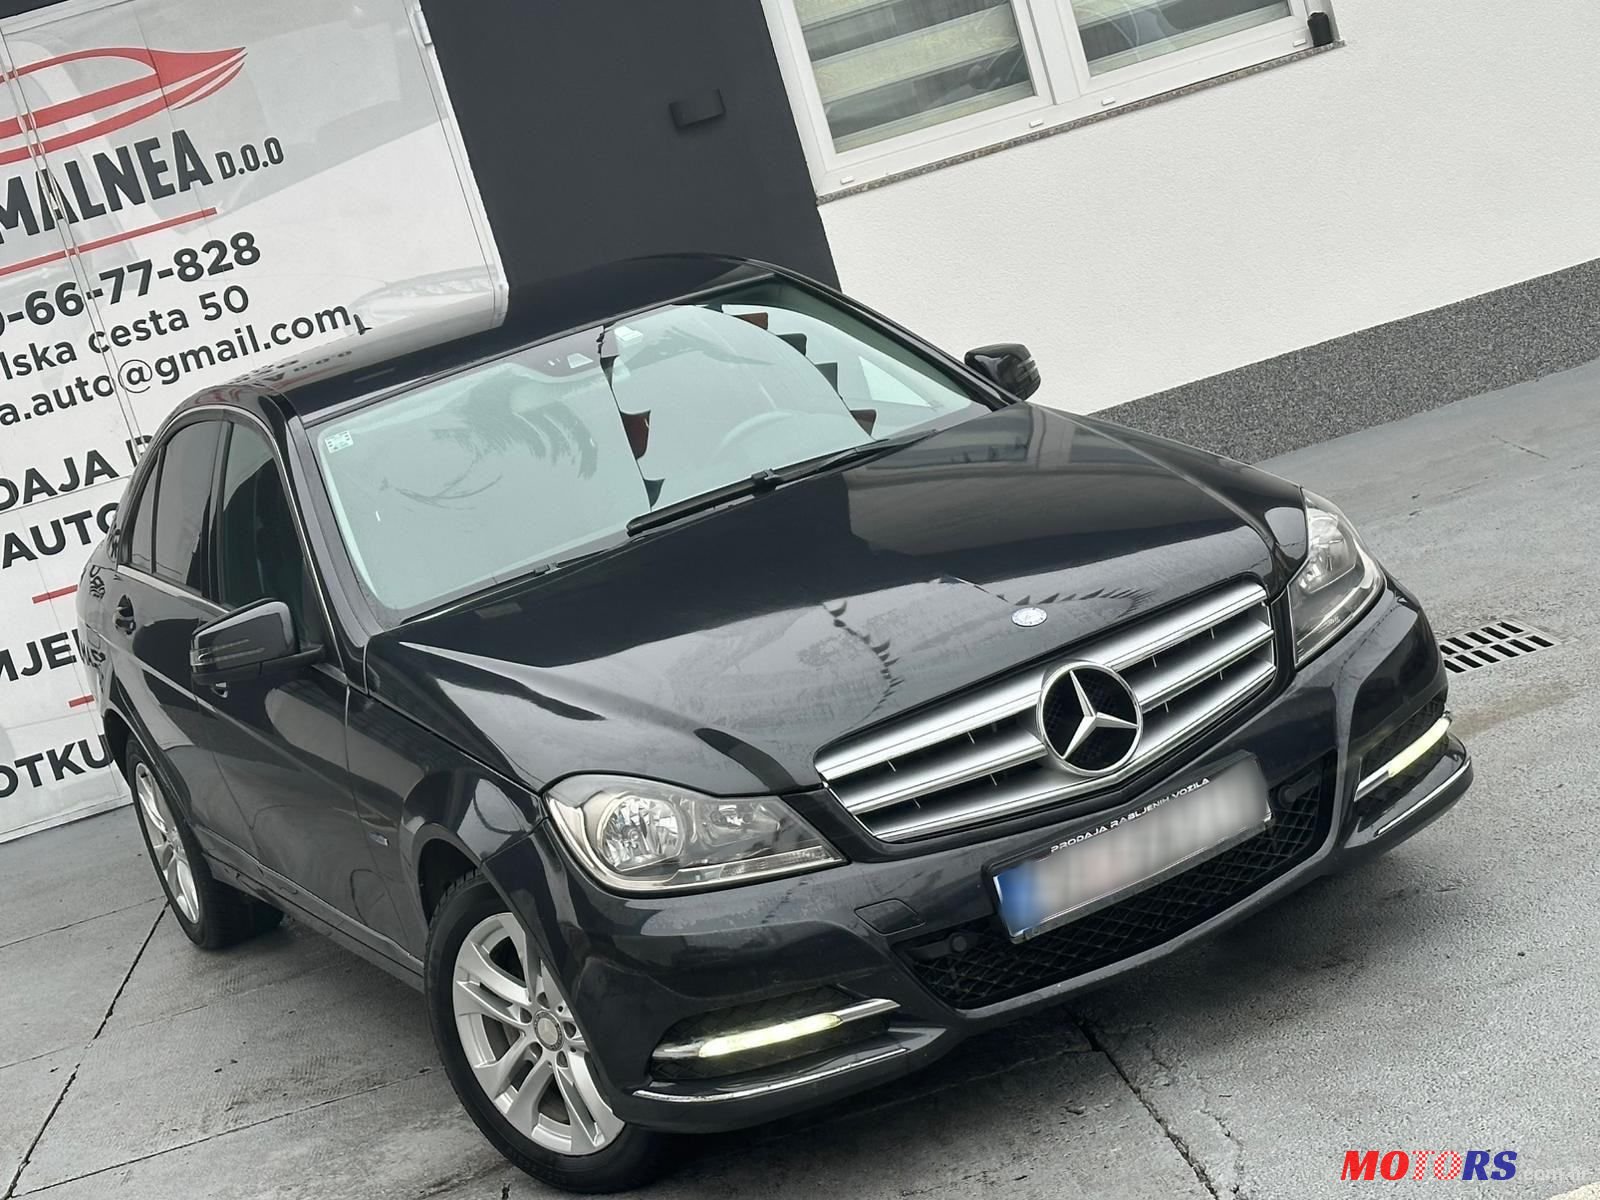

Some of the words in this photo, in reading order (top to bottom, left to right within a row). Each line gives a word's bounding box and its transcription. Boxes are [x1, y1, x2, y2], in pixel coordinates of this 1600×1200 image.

[215, 137, 285, 180] D.O.O
[0, 231, 261, 336] -66-77-828
[88, 309, 190, 354] cesta
[199, 285, 249, 321] 50
[1050, 825, 1108, 853] PRODAJA
[1110, 796, 1170, 828] RABLJENIH
[1171, 777, 1211, 799] VOZILA
